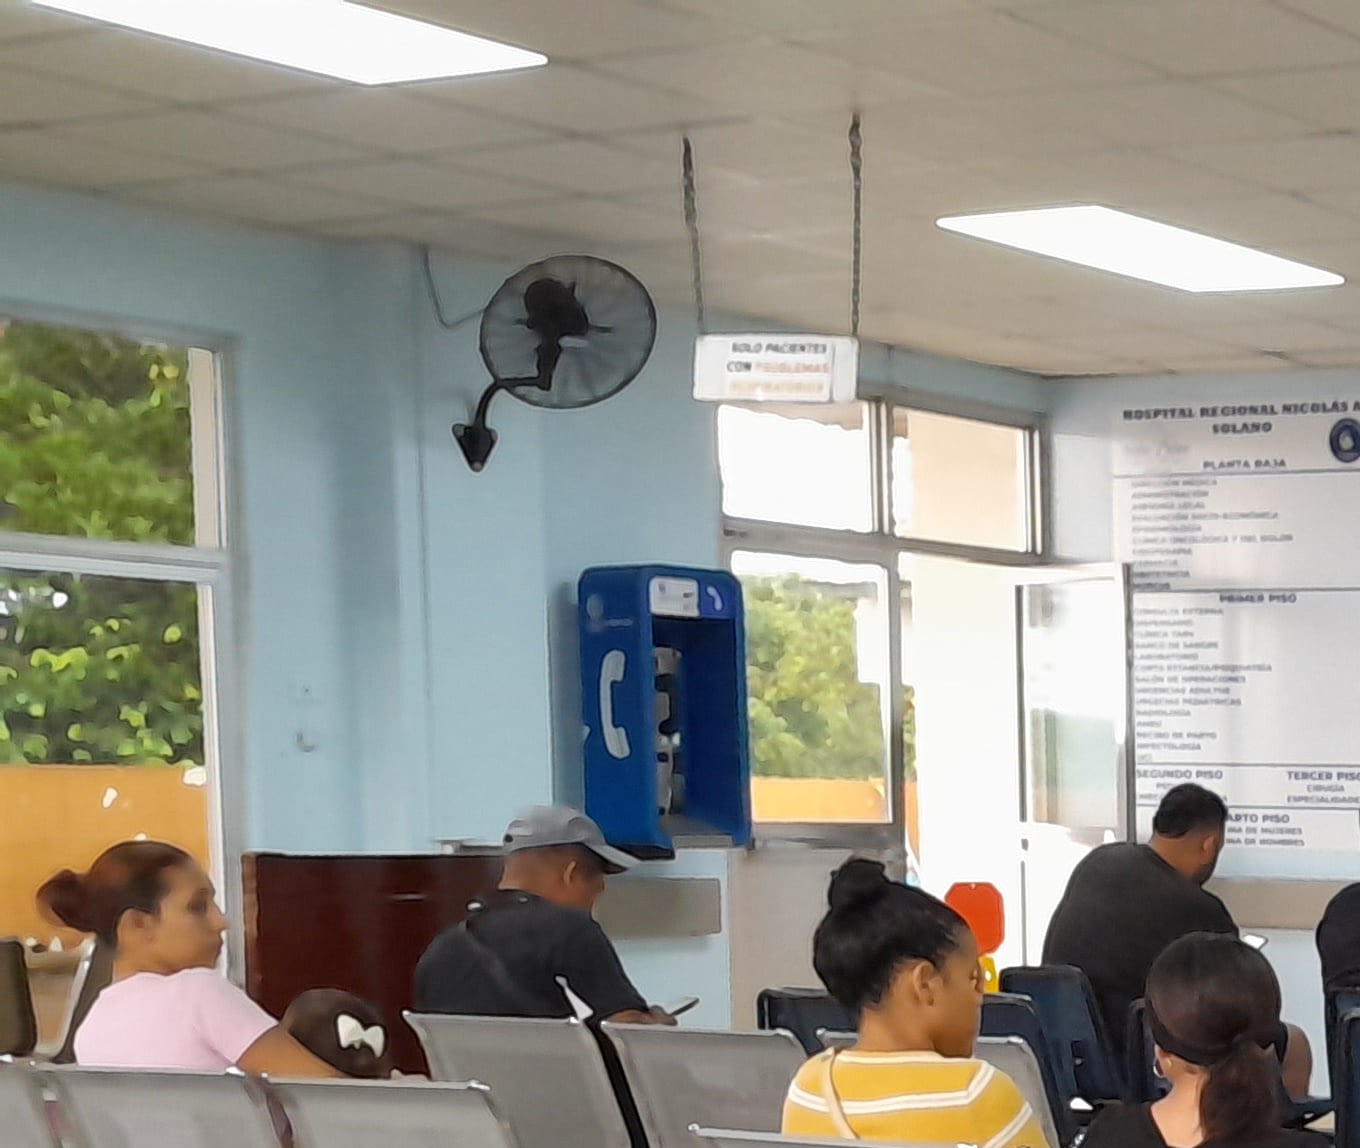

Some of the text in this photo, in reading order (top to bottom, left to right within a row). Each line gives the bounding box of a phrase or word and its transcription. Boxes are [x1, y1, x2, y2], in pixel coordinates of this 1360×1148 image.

[732, 342, 828, 354] SOLO PACIENTES
[727, 360, 752, 373] CON
[1123, 408, 1195, 420] HOSPITAL
[1200, 405, 1278, 419] REGIONAL
[1213, 421, 1272, 434] SOLANO
[1203, 458, 1287, 470] PLANTA BAJA
[1219, 594, 1297, 604] PRIMER PISO
[1137, 769, 1224, 780] SEGUNDO PISO
[1287, 771, 1333, 782] TERCER
[1262, 813, 1290, 824] PISO
